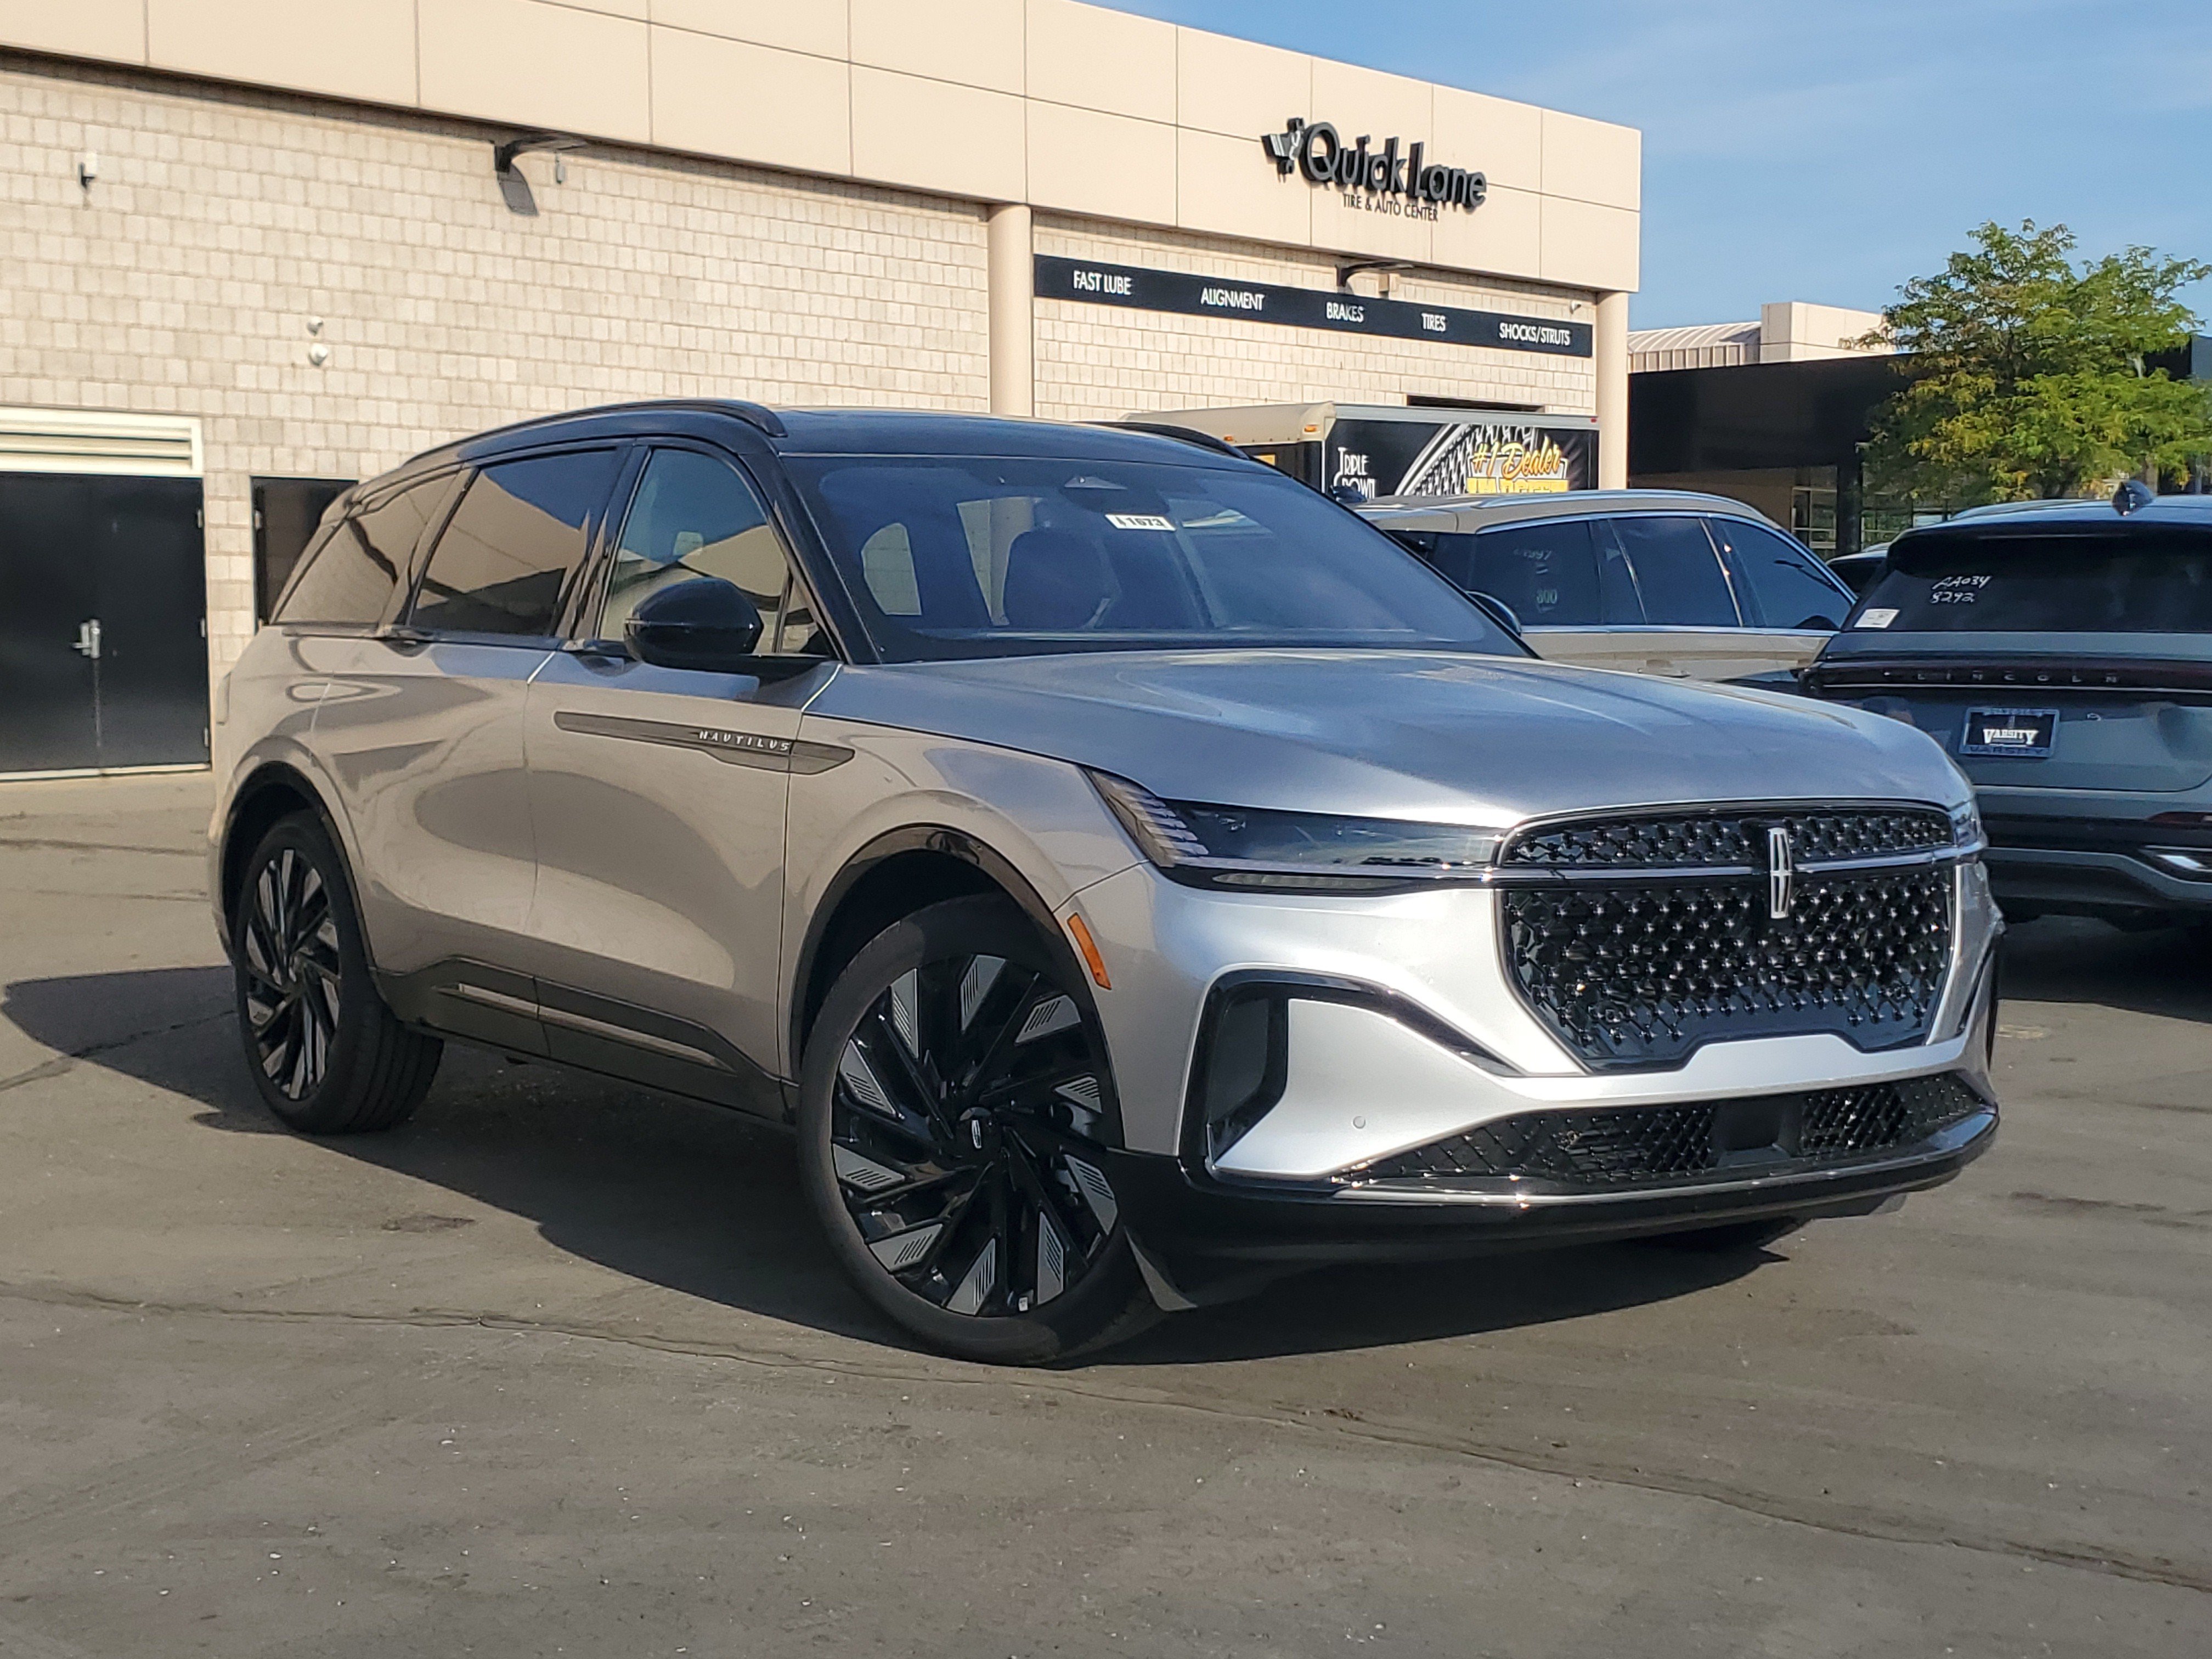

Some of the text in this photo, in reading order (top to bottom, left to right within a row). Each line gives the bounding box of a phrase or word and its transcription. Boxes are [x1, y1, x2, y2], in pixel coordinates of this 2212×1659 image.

[1344, 193, 1438, 222] TIRE & AUTO CENTER
[1073, 270, 1132, 296] FAST LUBE
[1200, 287, 1265, 311] ALIGNMENT
[1326, 302, 1364, 323] BRAKES
[1421, 313, 1447, 331] TIRES
[1499, 322, 1571, 346] SHOCKS/STRUTS
[1501, 435, 1561, 480] Dealer
[1931, 591, 1975, 603] 8292
[1916, 669, 2120, 684] LINCOLN
[699, 730, 791, 752] NAUTILUS
[1983, 728, 2039, 745] VARSITY
